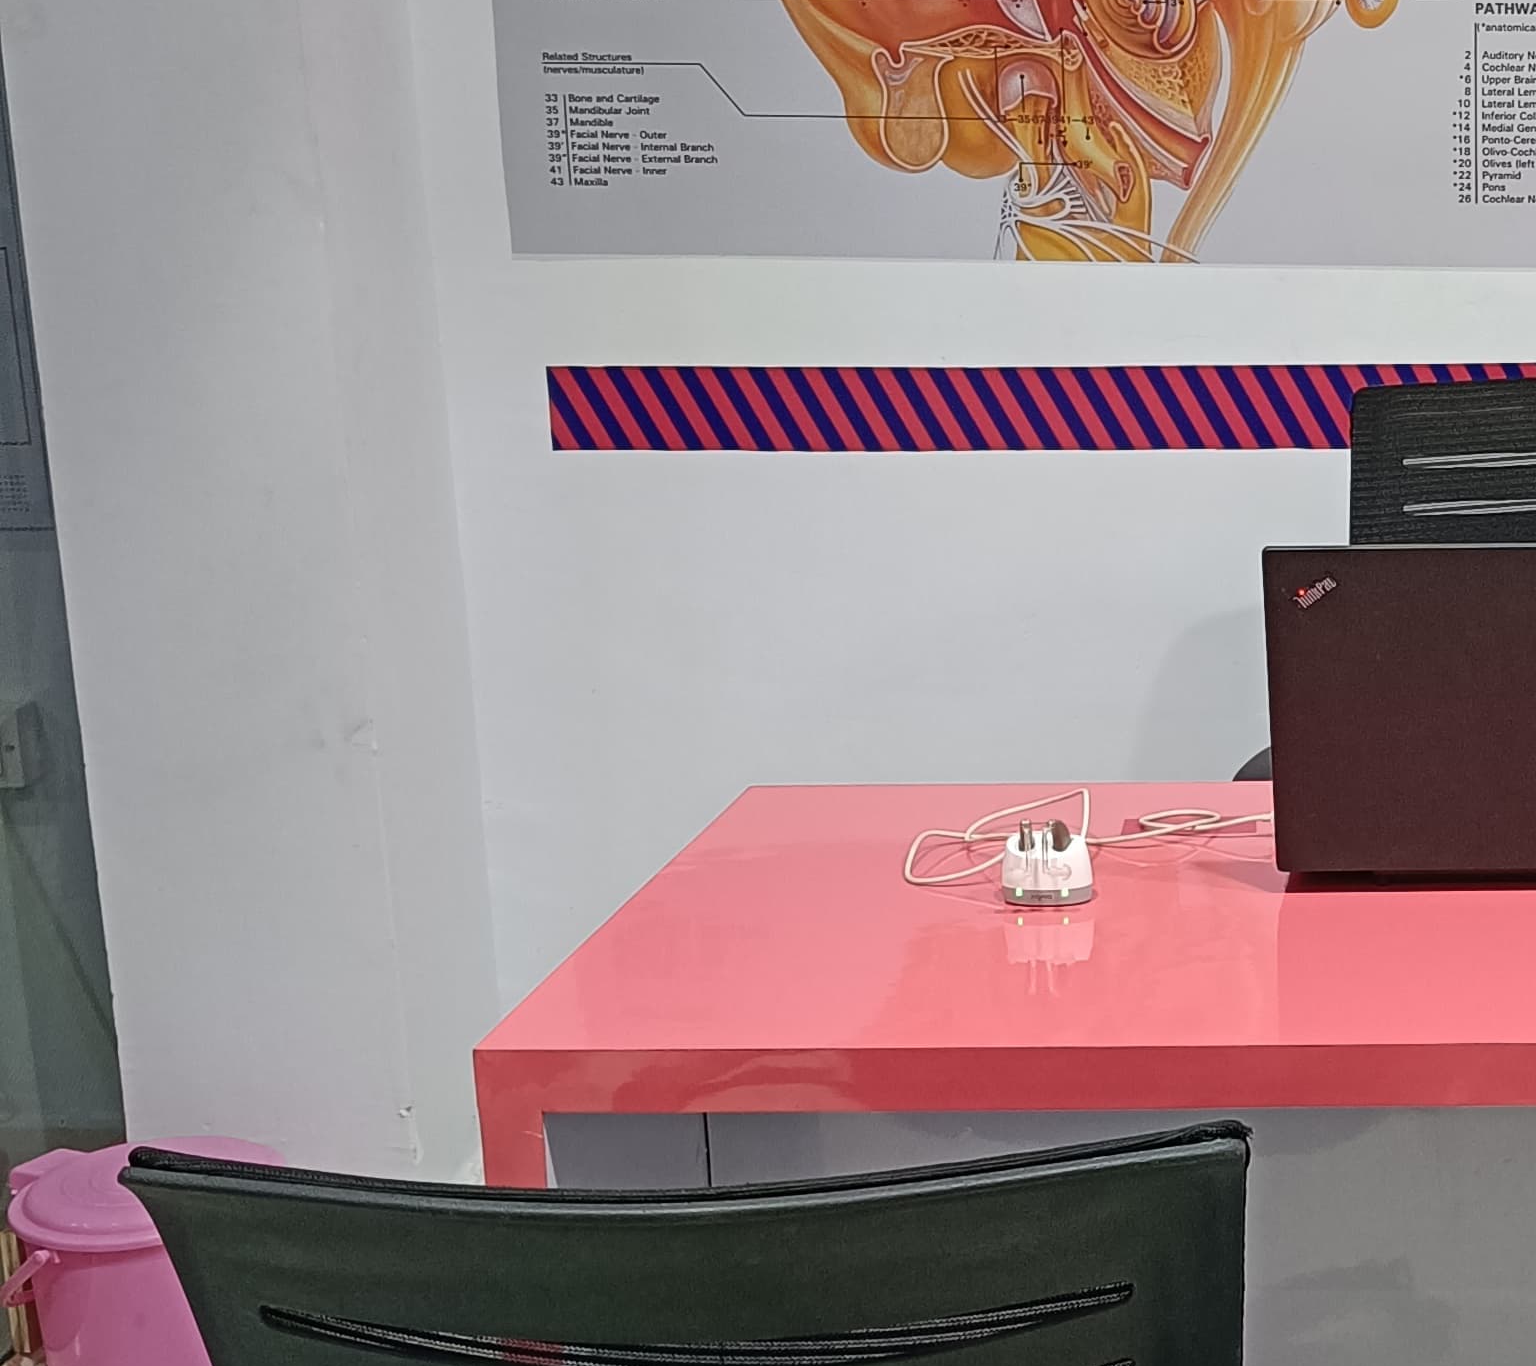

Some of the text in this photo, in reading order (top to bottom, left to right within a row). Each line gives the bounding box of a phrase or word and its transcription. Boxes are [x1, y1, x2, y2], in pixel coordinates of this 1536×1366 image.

[542, 53, 632, 61] Related Structures
[1482, 51, 1524, 62] Auditory
[1482, 63, 1525, 73] Cochlear
[1481, 76, 1511, 86] Upper
[1481, 87, 1514, 97] Lateral
[545, 94, 660, 105] 33 Bone and Cartilage
[1458, 100, 1470, 109] 10
[1481, 100, 1514, 109] Lateral
[569, 106, 650, 115] Mandibular Joint
[1481, 112, 1516, 121] Inferior
[546, 118, 614, 127] 37 Mandible
[570, 130, 667, 139] Facial Nerve Outer
[1482, 172, 1522, 181] Pyramid
[574, 178, 609, 187] Maxilla
[1482, 183, 1506, 192] Pons
